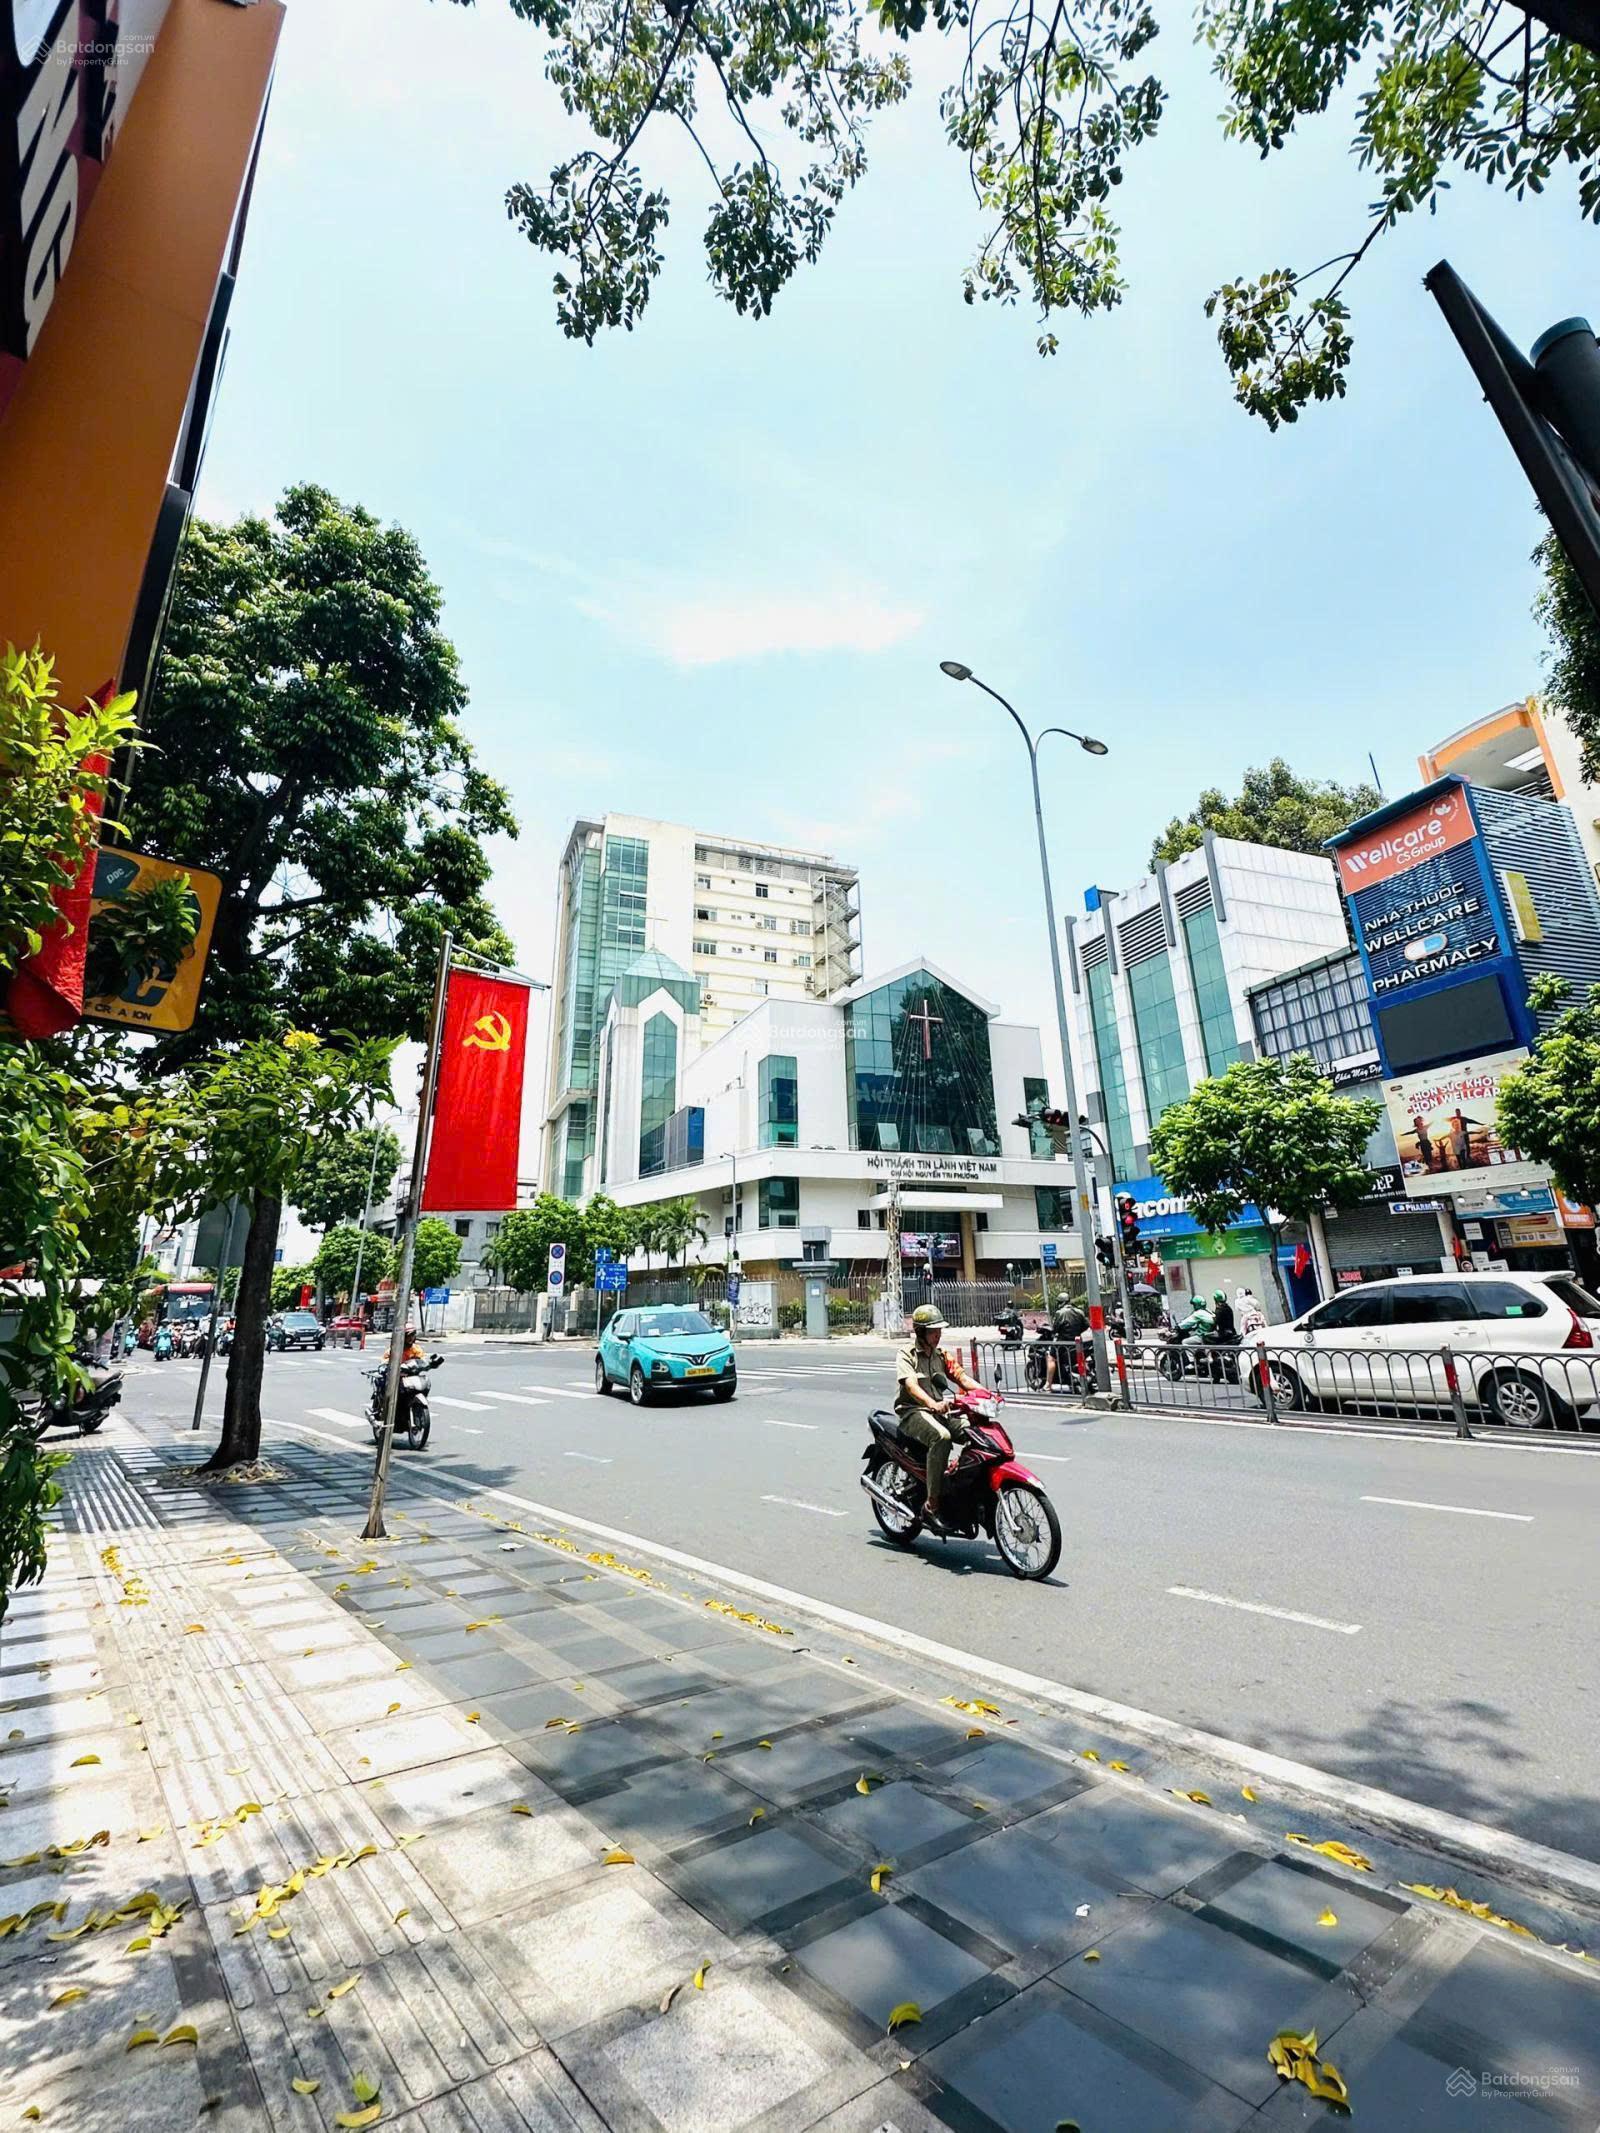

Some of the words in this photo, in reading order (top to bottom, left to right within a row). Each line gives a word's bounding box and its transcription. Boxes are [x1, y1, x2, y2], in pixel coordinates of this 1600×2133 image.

[1346, 819, 1443, 873] Wellcare
[1396, 852, 1411, 865] CS
[1411, 836, 1447, 858] Group
[1364, 897, 1480, 953] WELLCARE
[1372, 936, 1497, 993] PHARMACY
[1441, 1087, 1501, 1105] WELLCAR
[867, 1155, 883, 1168] HỘI
[917, 1159, 931, 1170] TIN
[933, 1158, 957, 1171] LÀNH
[959, 1160, 977, 1172] VIỆT
[979, 1163, 997, 1172] NAM
[1404, 1202, 1446, 1213] PHARMACY
